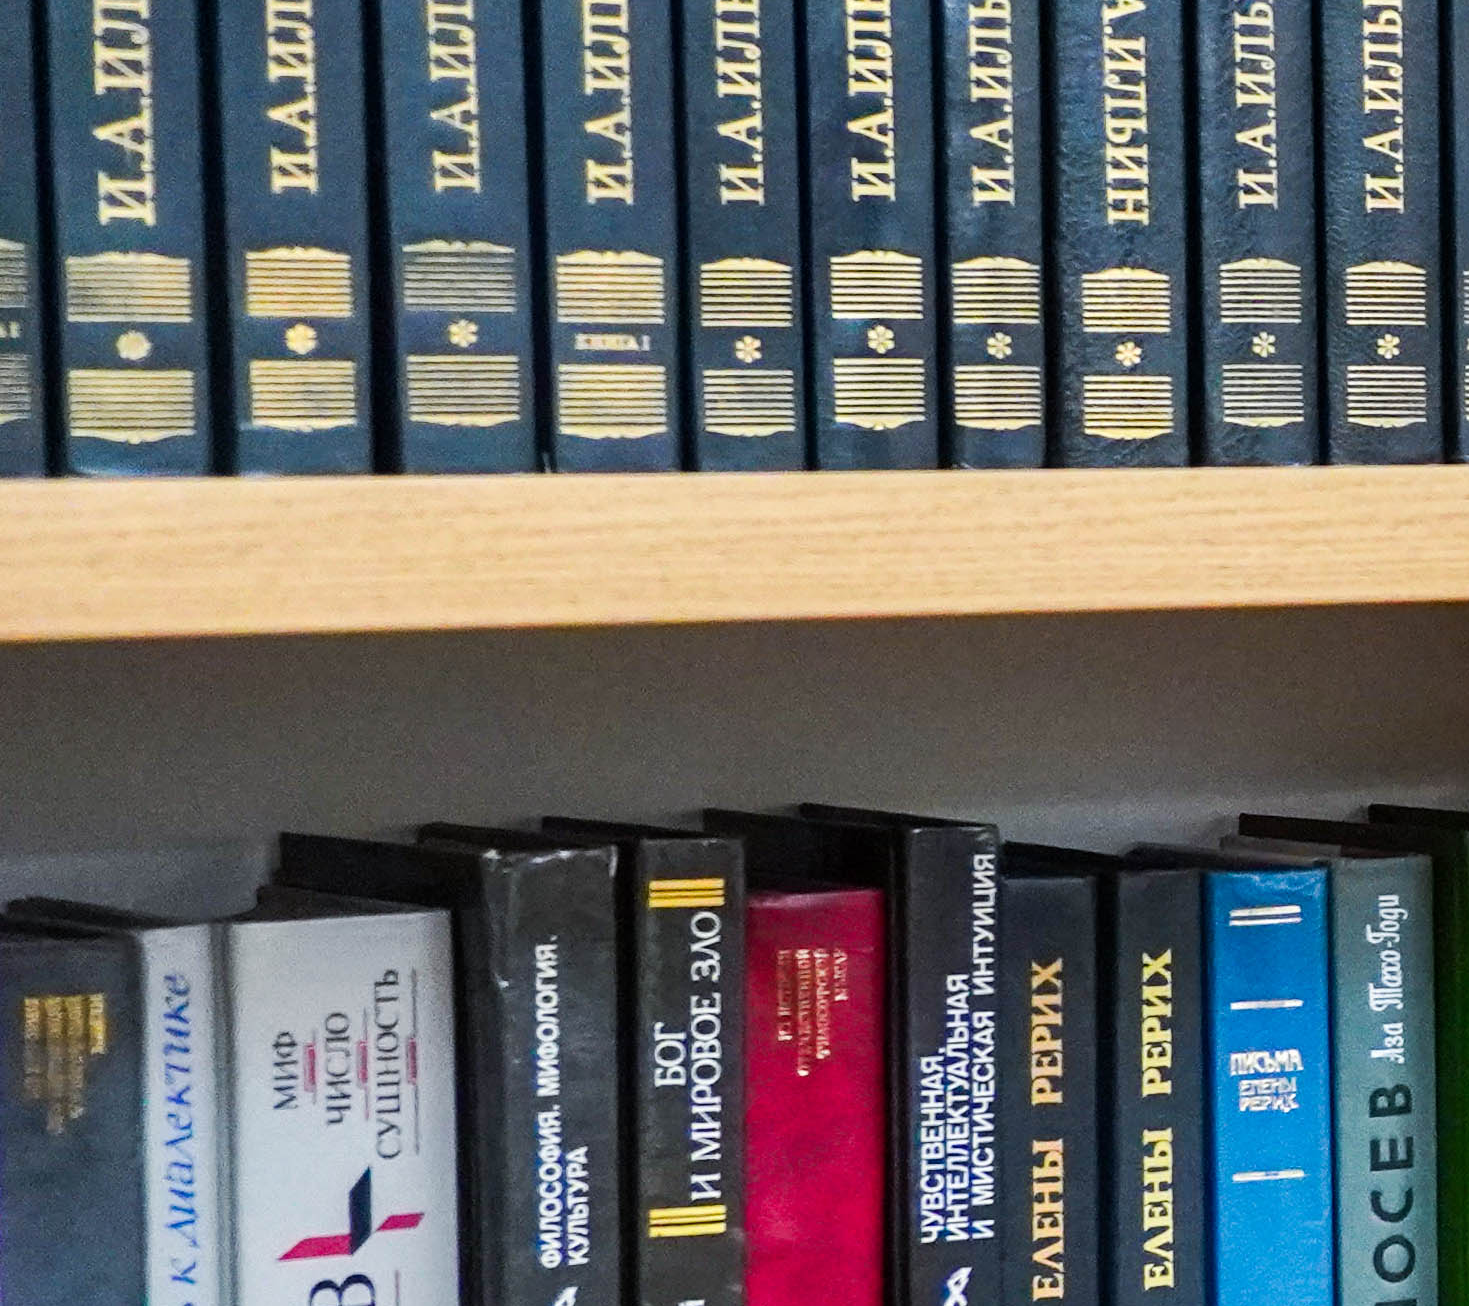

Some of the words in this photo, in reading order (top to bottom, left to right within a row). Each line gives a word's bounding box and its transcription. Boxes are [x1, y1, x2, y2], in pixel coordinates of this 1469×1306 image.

[688, 911, 722, 982] ЗЛО
[1139, 949, 1175, 1096] РЕРИХ
[271, 1029, 299, 1112] МИФ
[325, 1011, 351, 1125] ЧИСЛО
[374, 966, 402, 1160] СУЩНОСТЬ
[654, 1020, 688, 1090] БОГ
[689, 990, 722, 1166] МИРОВОЕ
[943, 972, 970, 1244] ИНТЕЛЛЕКТУАЛЬНАЯ
[969, 1012, 995, 1205] МИСТИЧЕСКАЯ
[1028, 957, 1064, 1107] РЕРИХ
[538, 1102, 564, 1270] ФИЛОСОФИЯ.
[566, 1143, 590, 1268] КУЛЬТУРА
[1028, 1136, 1064, 1301] ЕЛЕНЫ
[1142, 1126, 1177, 1292] ЕЛЕНЫ
